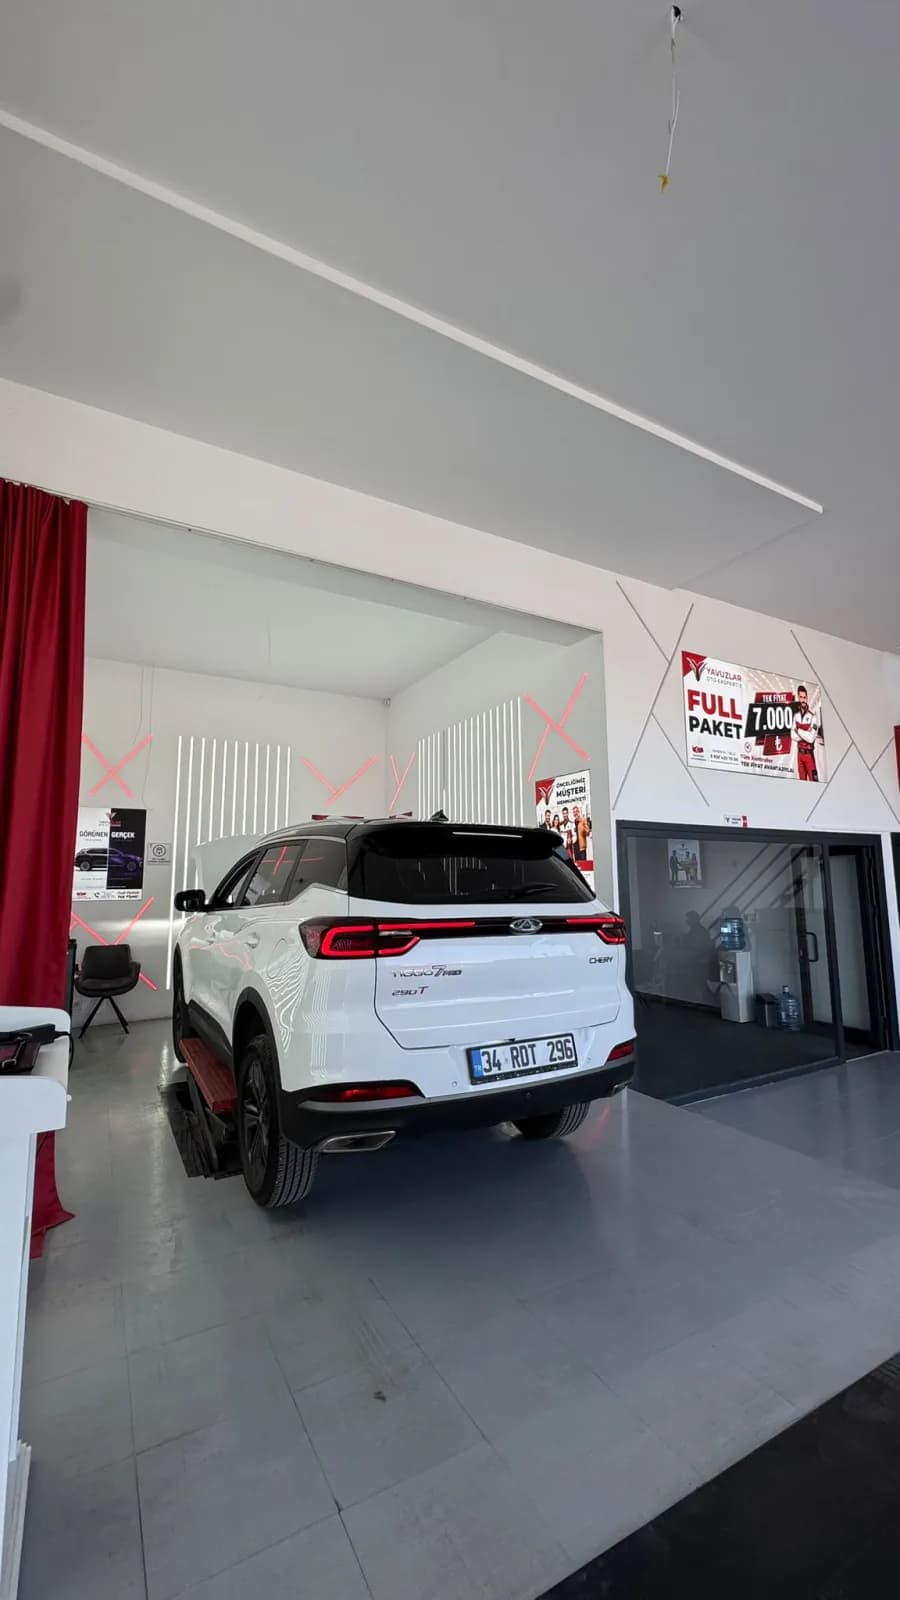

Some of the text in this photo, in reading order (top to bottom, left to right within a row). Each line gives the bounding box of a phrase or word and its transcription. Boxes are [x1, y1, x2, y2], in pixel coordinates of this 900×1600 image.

[706, 667, 742, 682] YAVUZLAR
[687, 689, 743, 720] FULL
[689, 715, 743, 739] PAKET
[752, 706, 793, 731] 7.000
[556, 783, 586, 798] MÜŞTERİ
[110, 831, 136, 840] GERÇEK
[589, 956, 614, 965] CHERY
[481, 1049, 502, 1073] 34
[547, 1038, 574, 1062] 296
